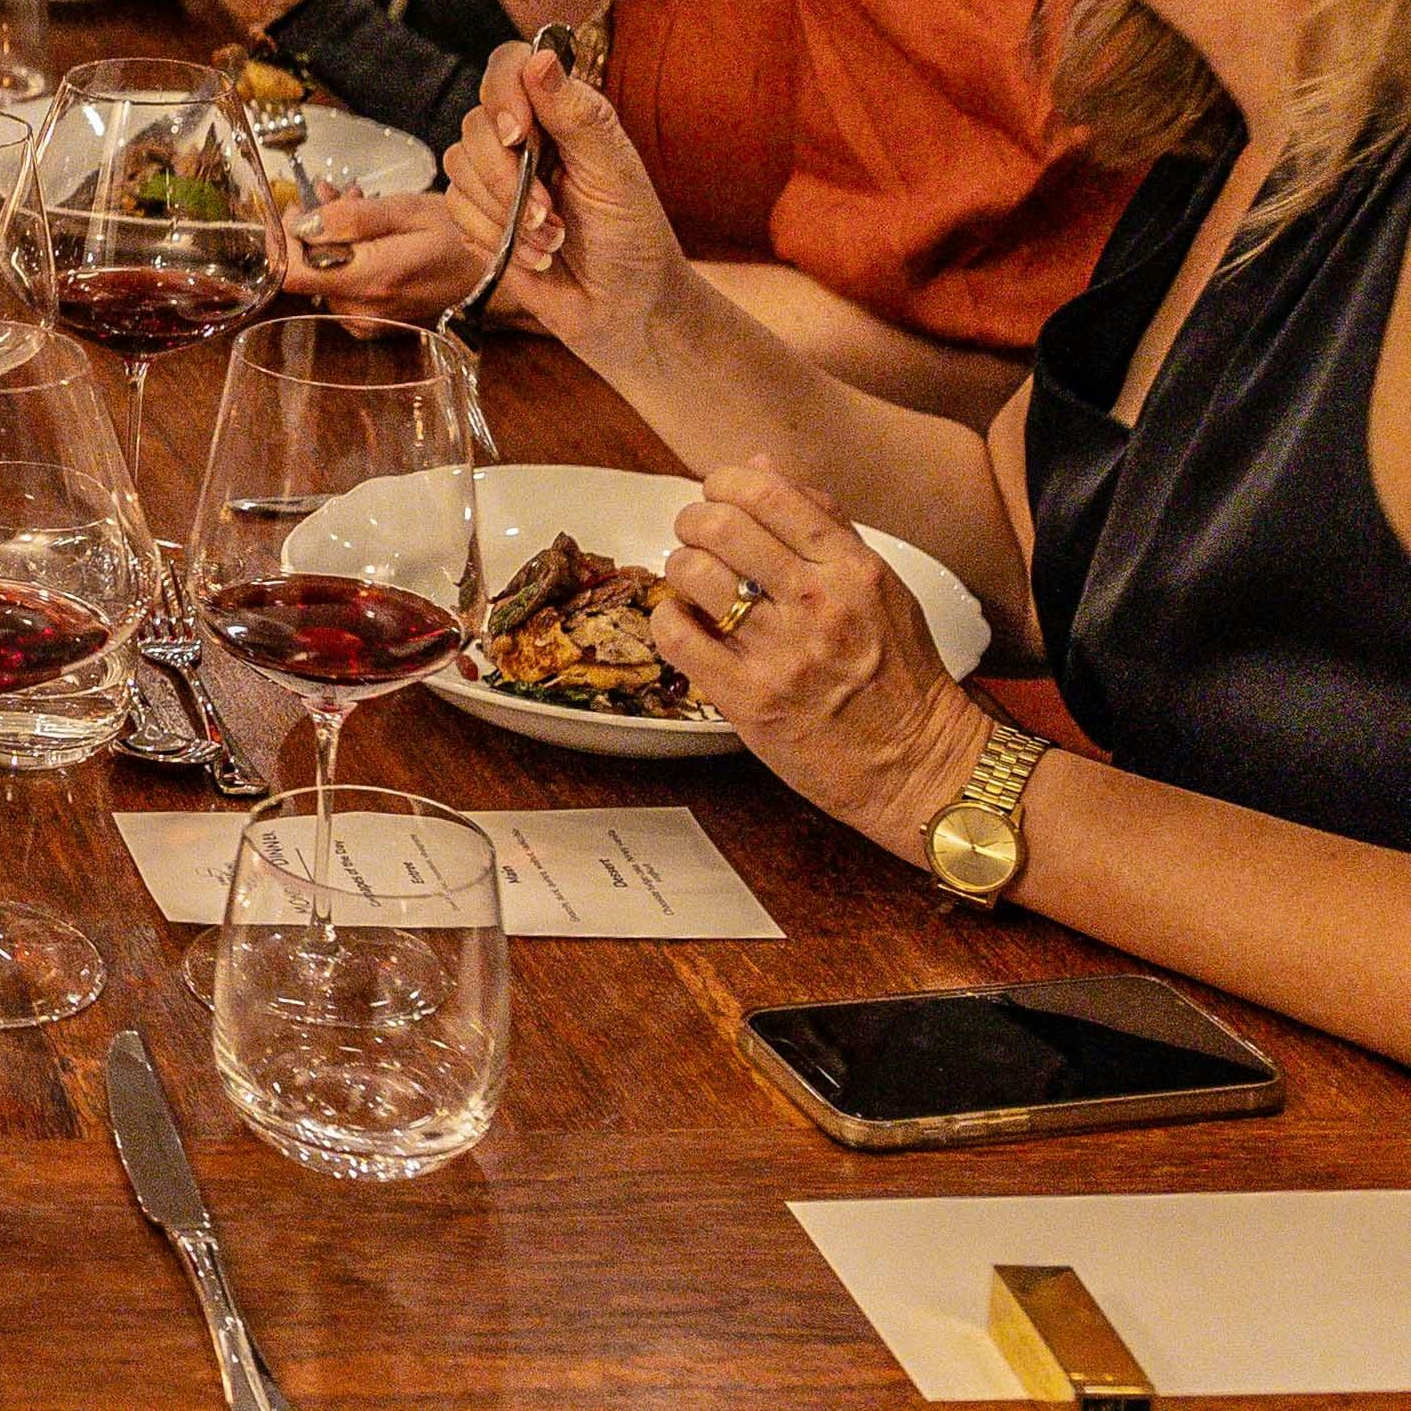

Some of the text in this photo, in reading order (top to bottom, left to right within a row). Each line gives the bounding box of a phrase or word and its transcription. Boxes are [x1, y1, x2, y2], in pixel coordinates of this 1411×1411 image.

[334, 840, 347, 855] Day
[340, 855, 354, 867] the
[500, 866, 521, 884] Main
[599, 858, 628, 888] Dessert
